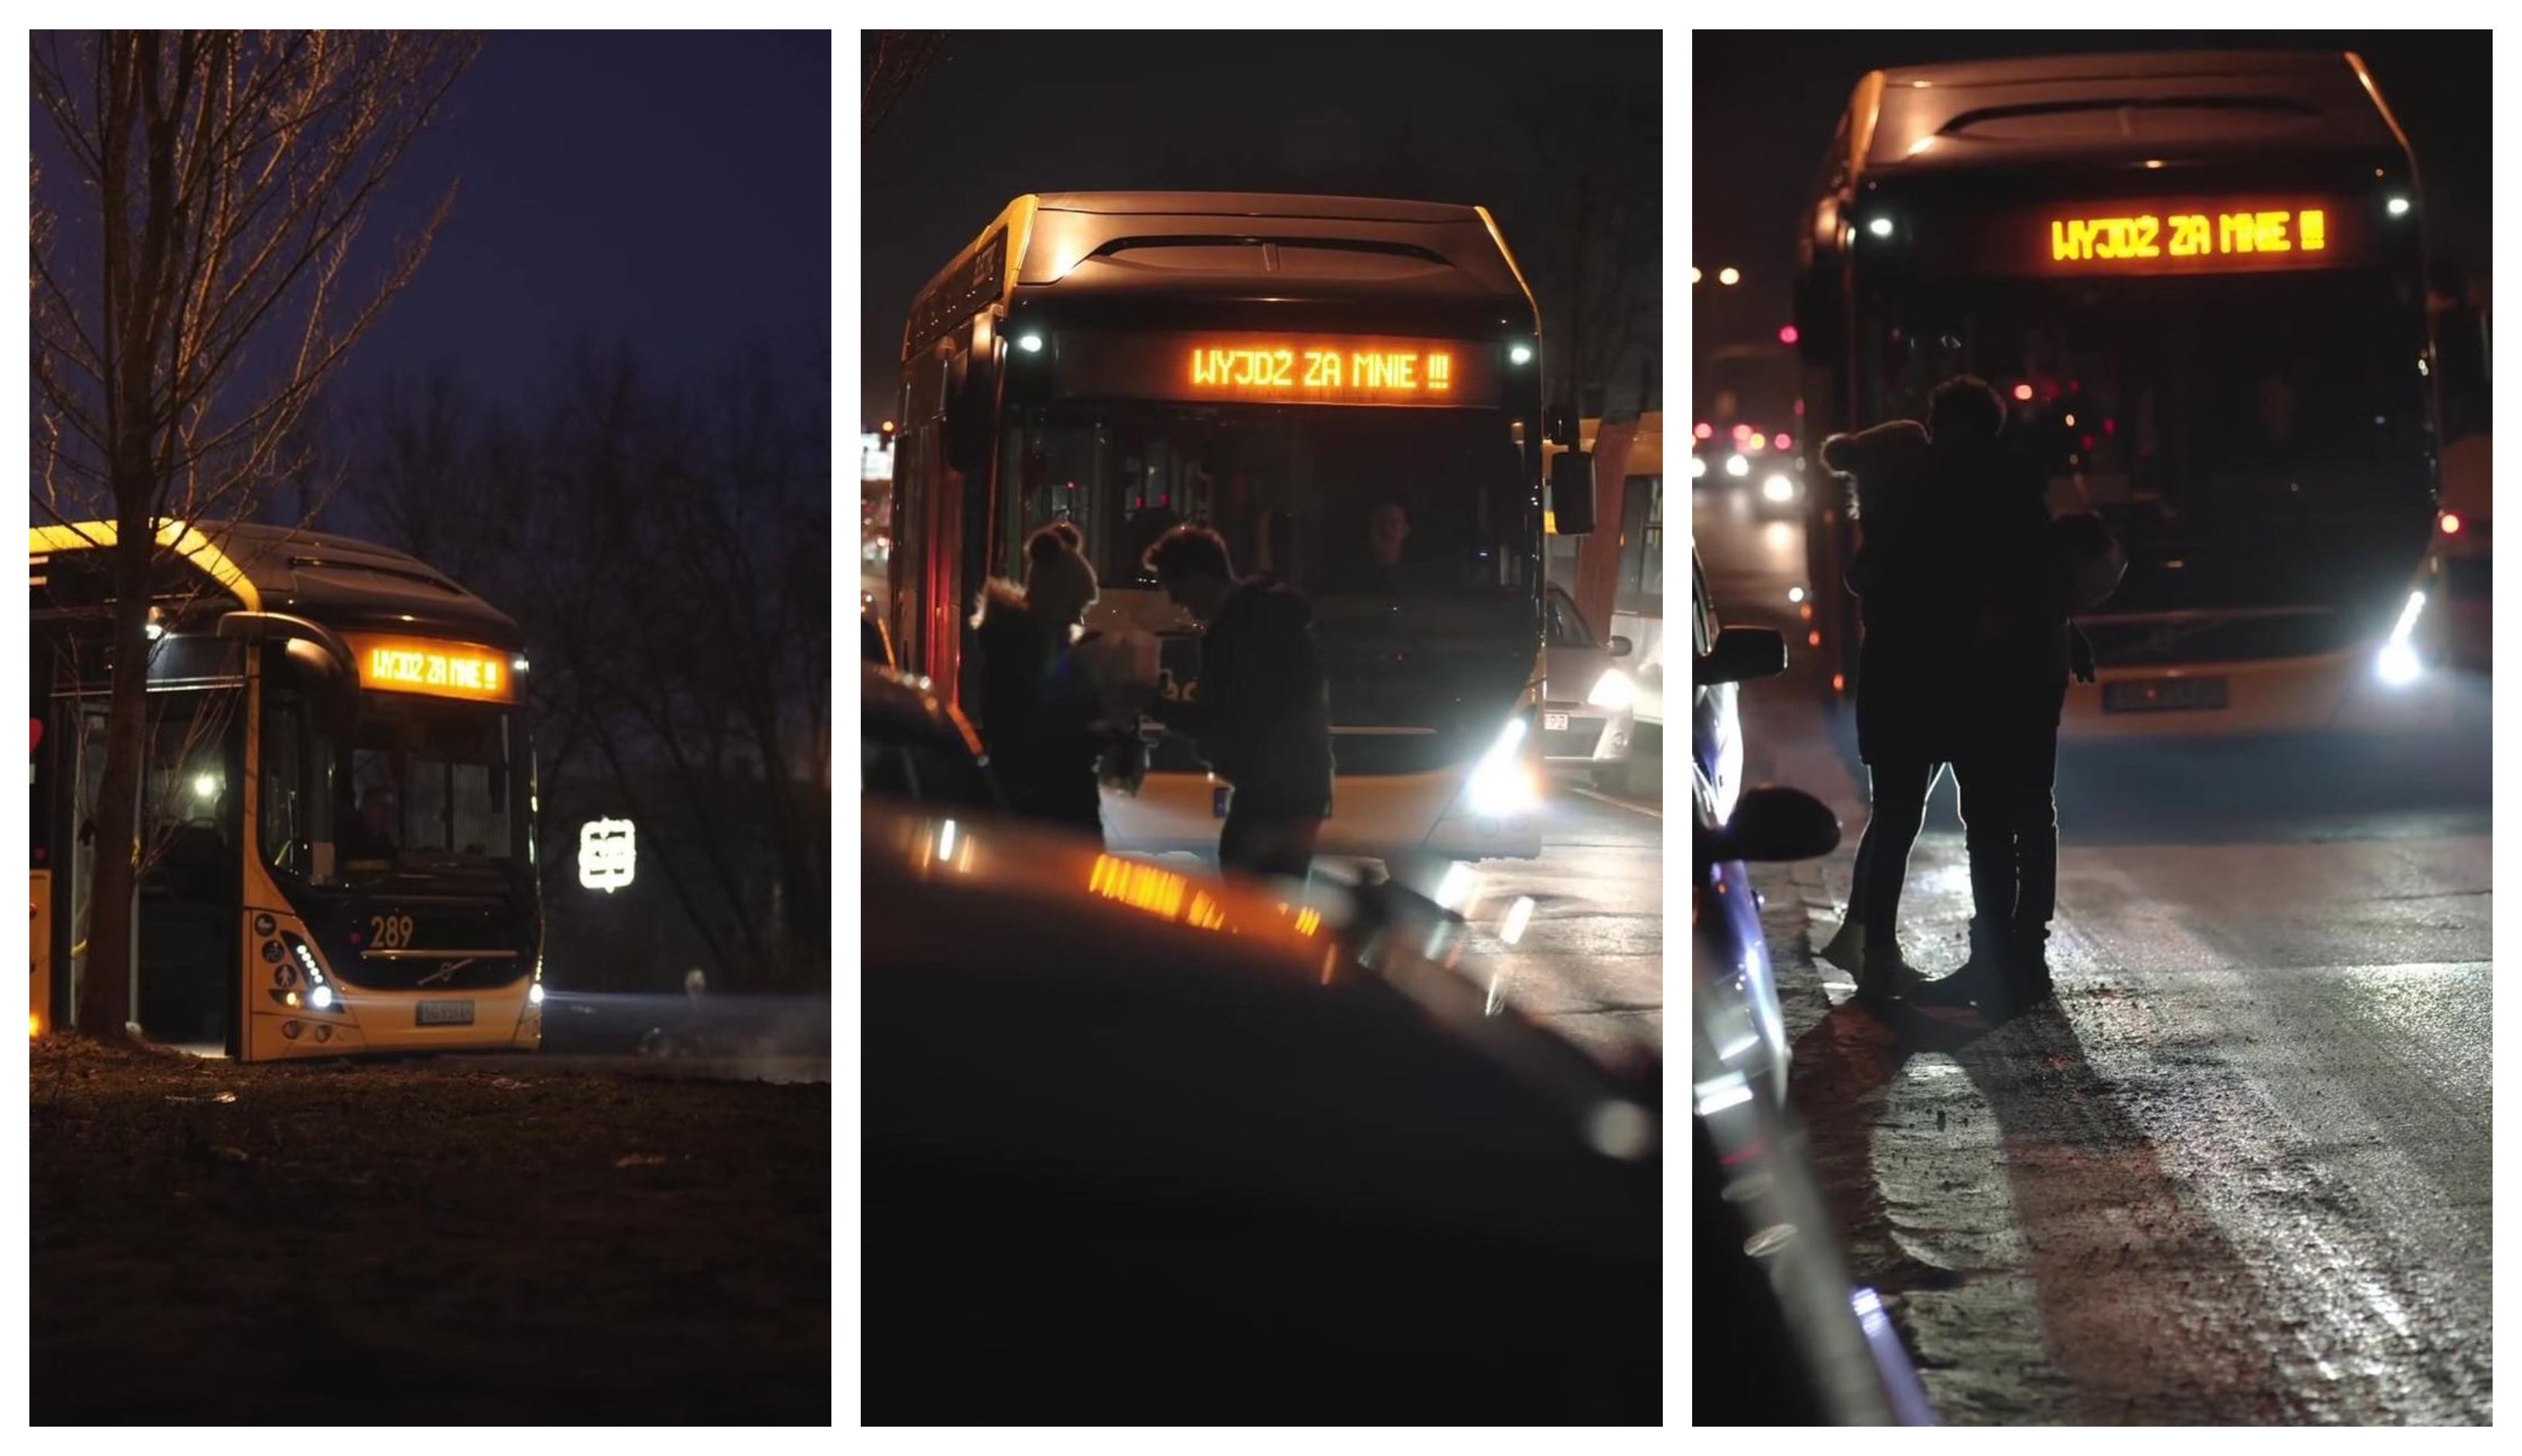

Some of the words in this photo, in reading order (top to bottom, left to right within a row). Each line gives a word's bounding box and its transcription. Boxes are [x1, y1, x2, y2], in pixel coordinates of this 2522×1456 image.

[2168, 215, 2211, 256] ZA
[2219, 211, 2291, 253] MNIE
[1303, 351, 1341, 387] ZA
[1352, 352, 1417, 389] MNIE
[1428, 354, 1449, 389] !!!
[426, 654, 447, 686] ZA
[371, 916, 413, 948] 289
